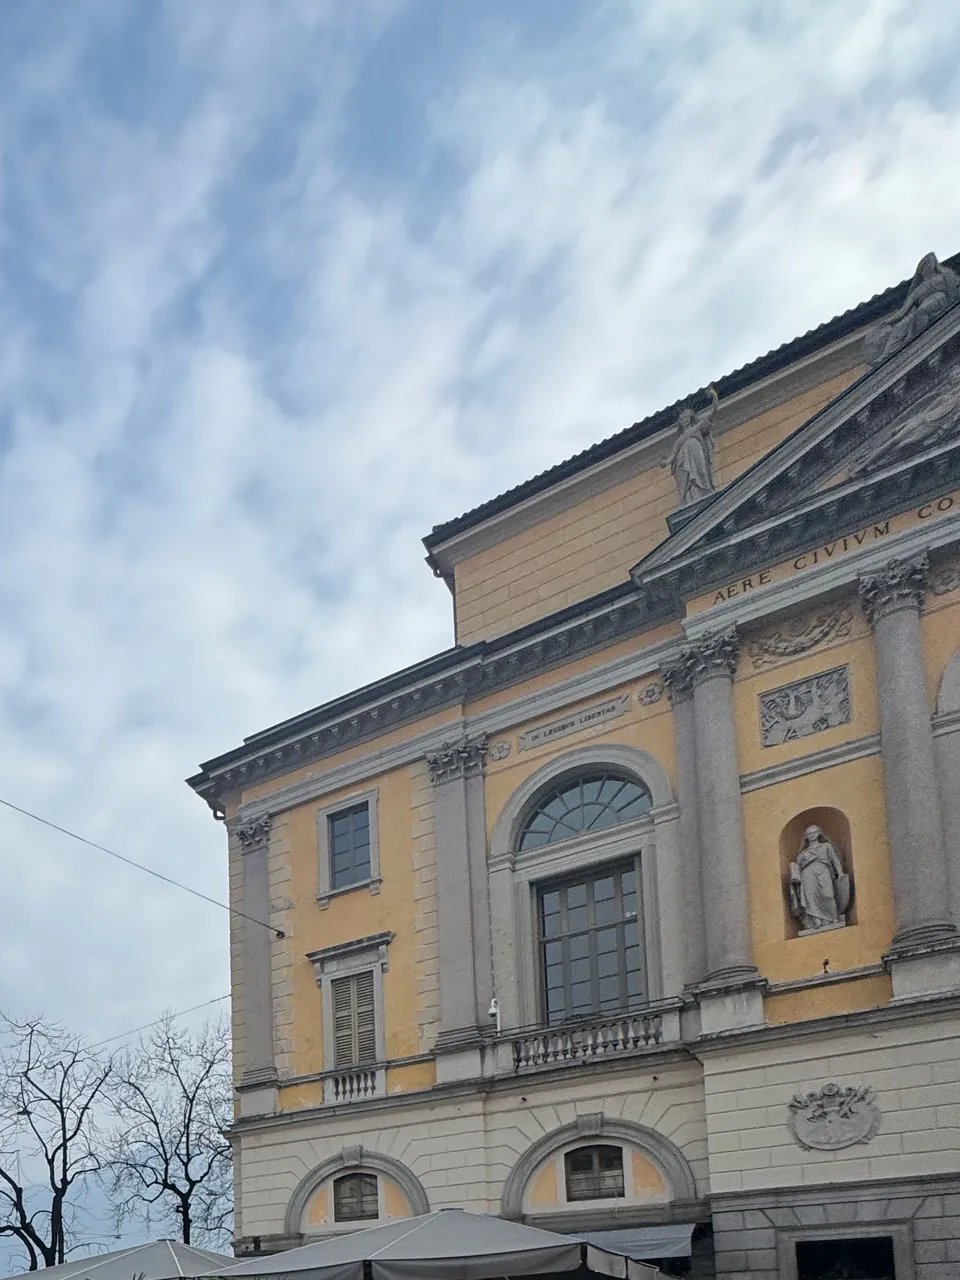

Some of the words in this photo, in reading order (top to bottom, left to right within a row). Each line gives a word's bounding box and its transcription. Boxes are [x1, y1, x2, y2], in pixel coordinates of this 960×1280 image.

[712, 570, 772, 604] AERE
[793, 521, 891, 570] CIVIVM
[917, 496, 953, 519] CO
[531, 733, 540, 742] IN
[579, 705, 617, 724] LIBERTAS
